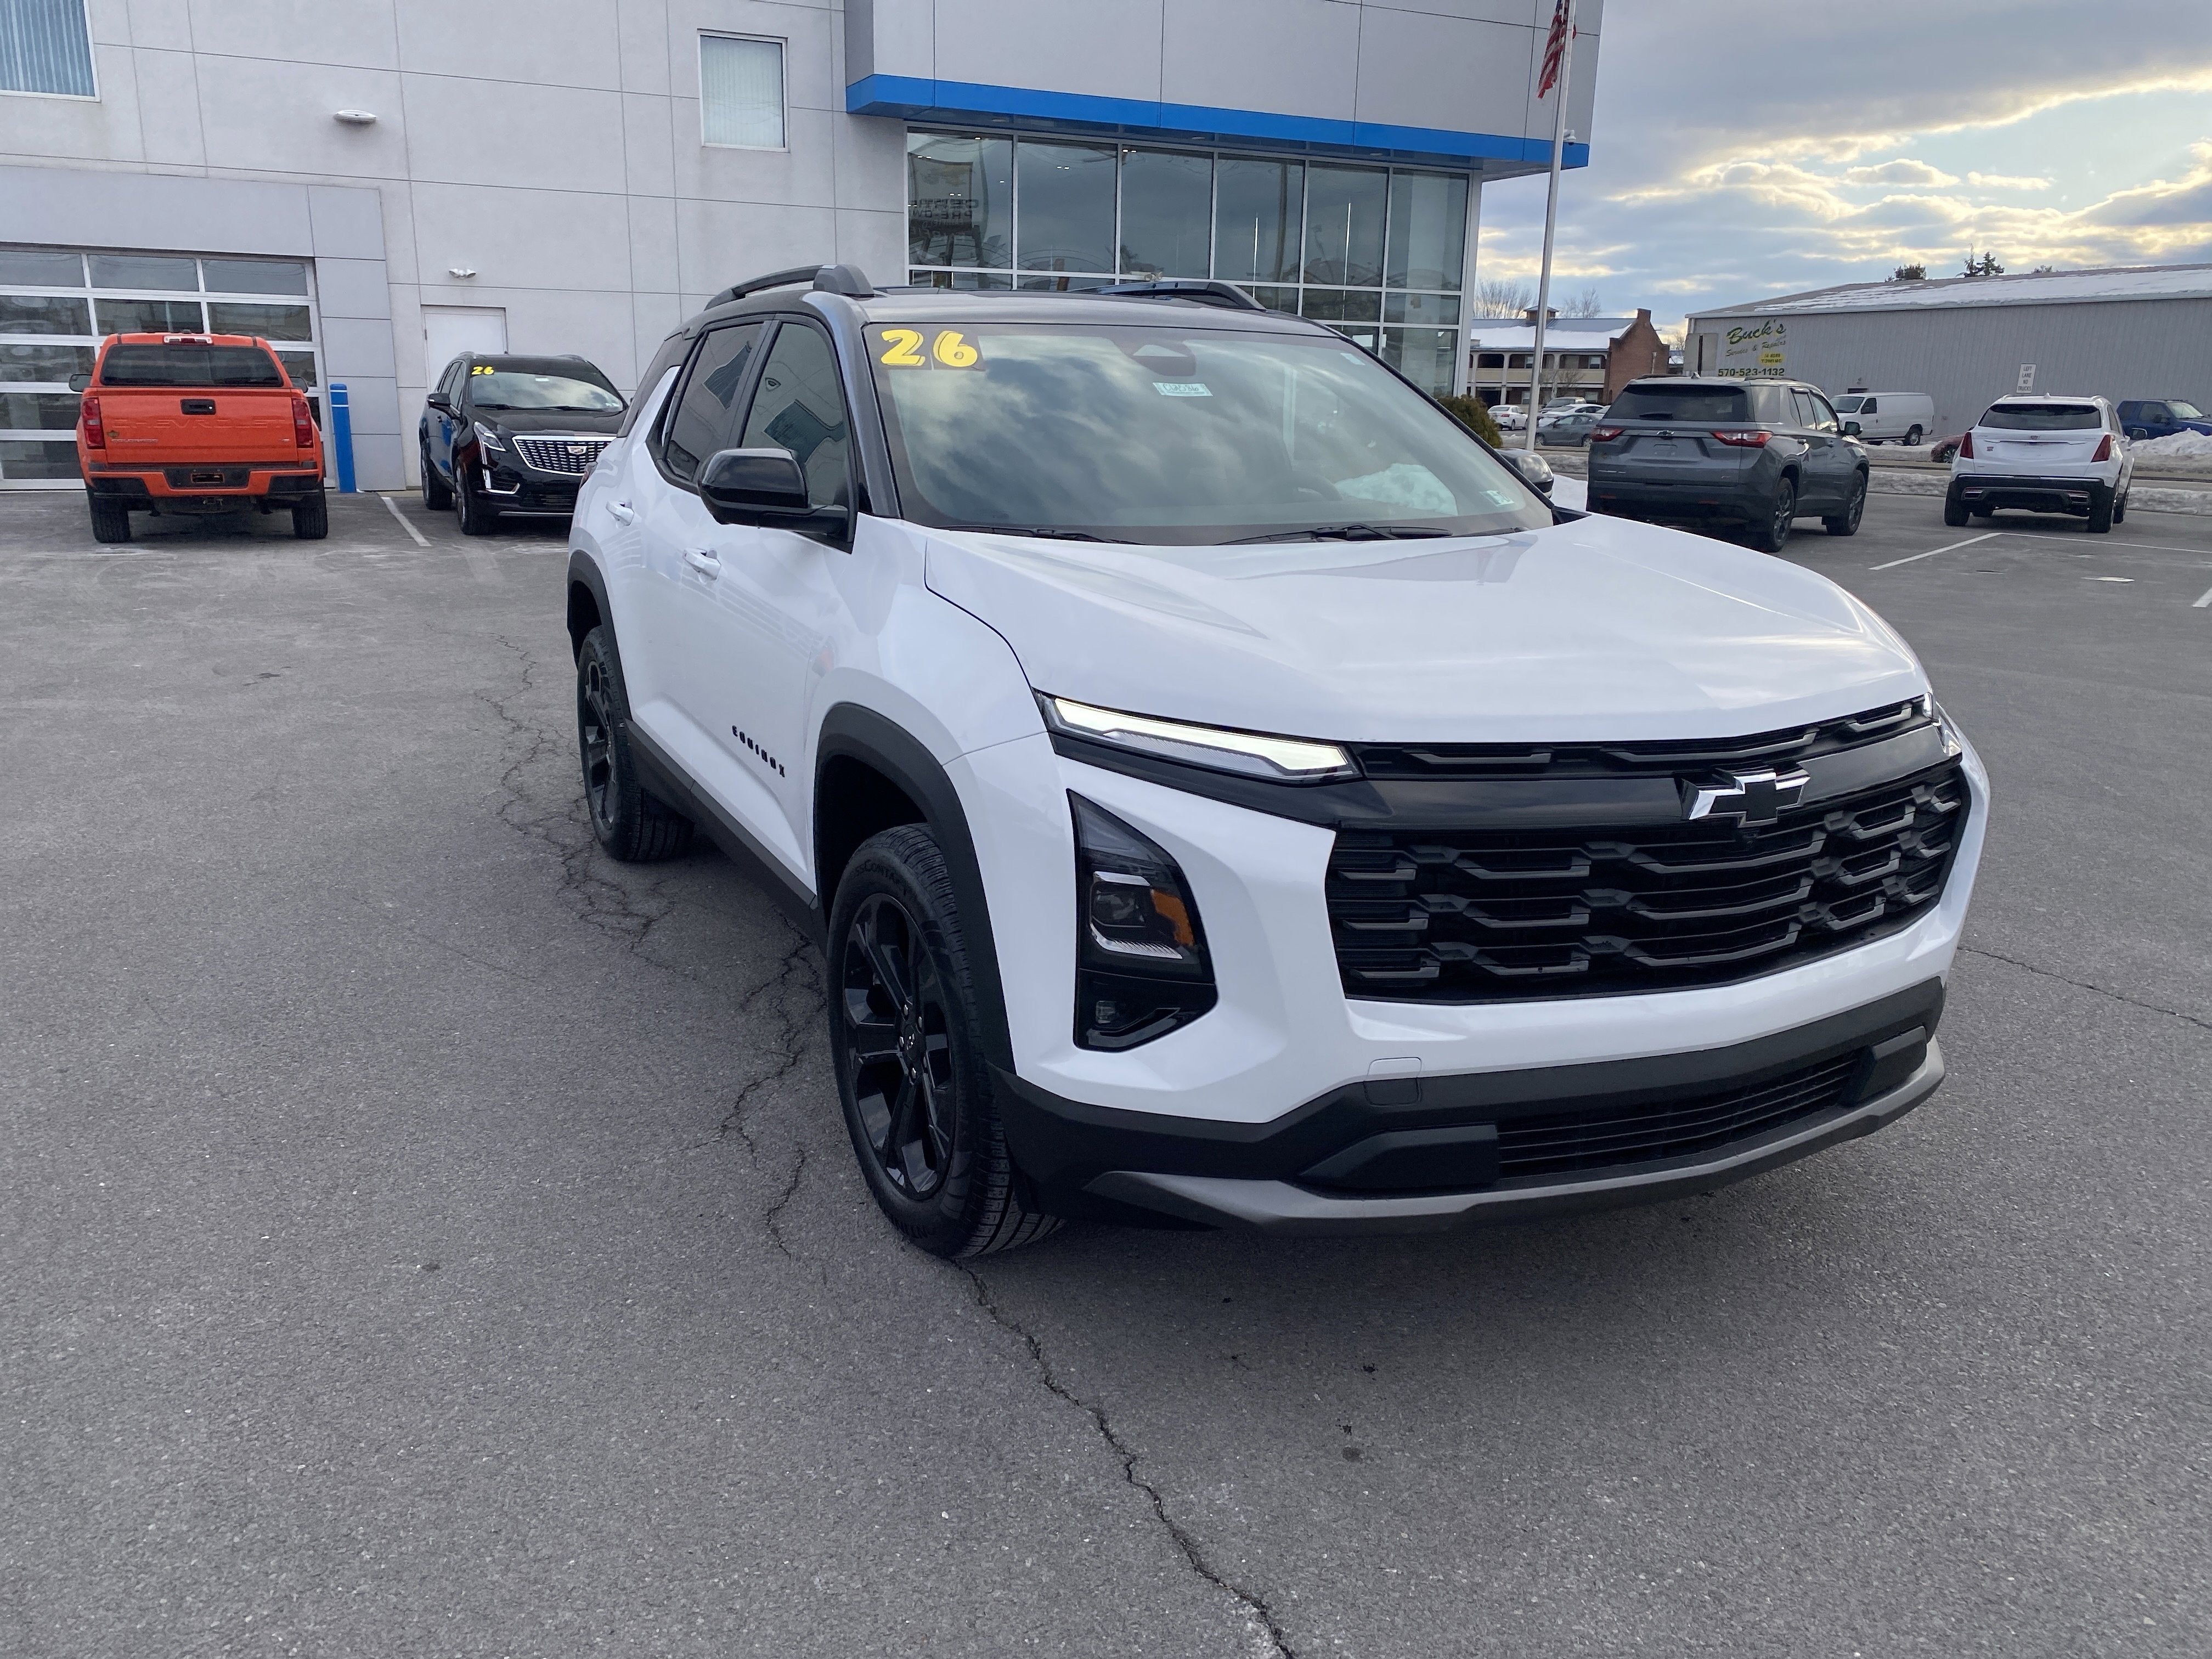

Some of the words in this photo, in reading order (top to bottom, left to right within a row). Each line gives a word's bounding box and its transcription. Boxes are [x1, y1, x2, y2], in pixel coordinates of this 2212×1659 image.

[1726, 319, 1787, 345] Buck's
[881, 329, 978, 367] 26
[471, 366, 494, 375] 26
[1718, 368, 1785, 377] 570-523-1132
[111, 419, 286, 428] CHEVROLET
[732, 725, 786, 778] EQUINOX
